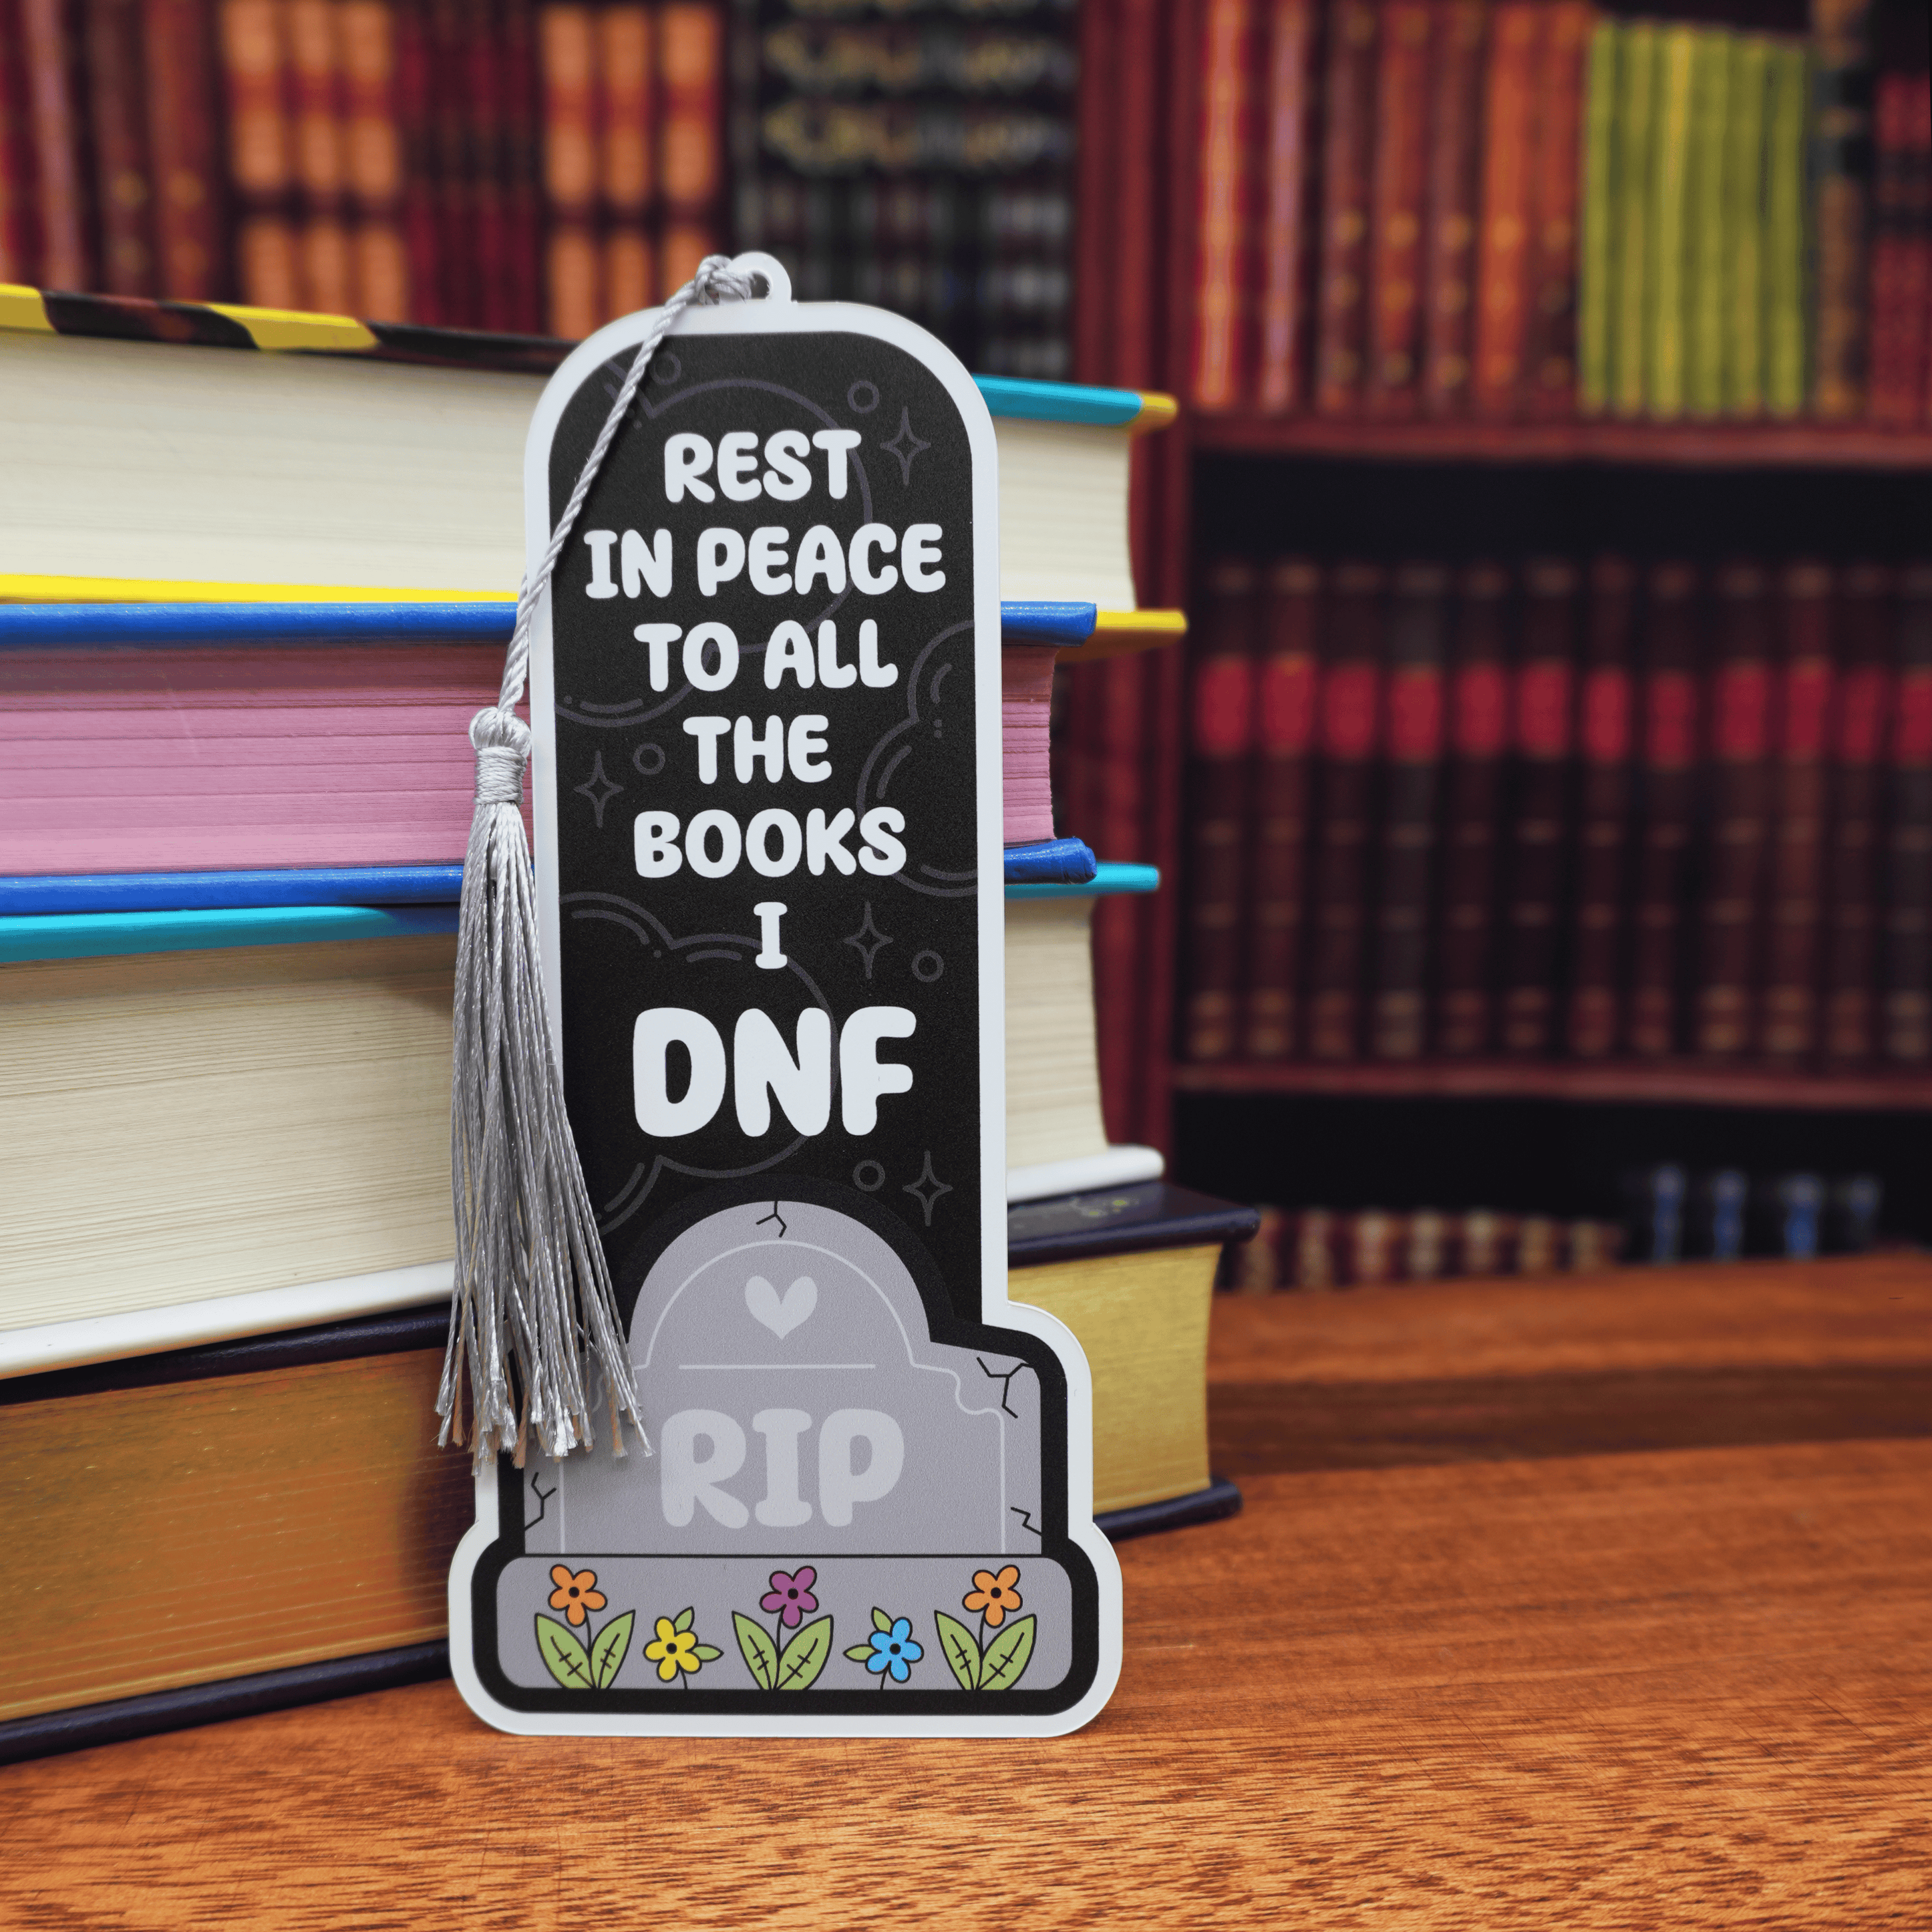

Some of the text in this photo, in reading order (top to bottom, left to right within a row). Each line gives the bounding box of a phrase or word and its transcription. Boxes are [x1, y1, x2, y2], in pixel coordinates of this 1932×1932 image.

[664, 429, 862, 503] REST
[583, 522, 946, 599] IN PEACE
[633, 619, 899, 692] TO ALL
[683, 714, 832, 784] THE
[634, 806, 907, 878] BOOKS
[754, 901, 788, 970] I
[633, 1005, 917, 1137] DNF
[661, 1408, 905, 1529] RIP
